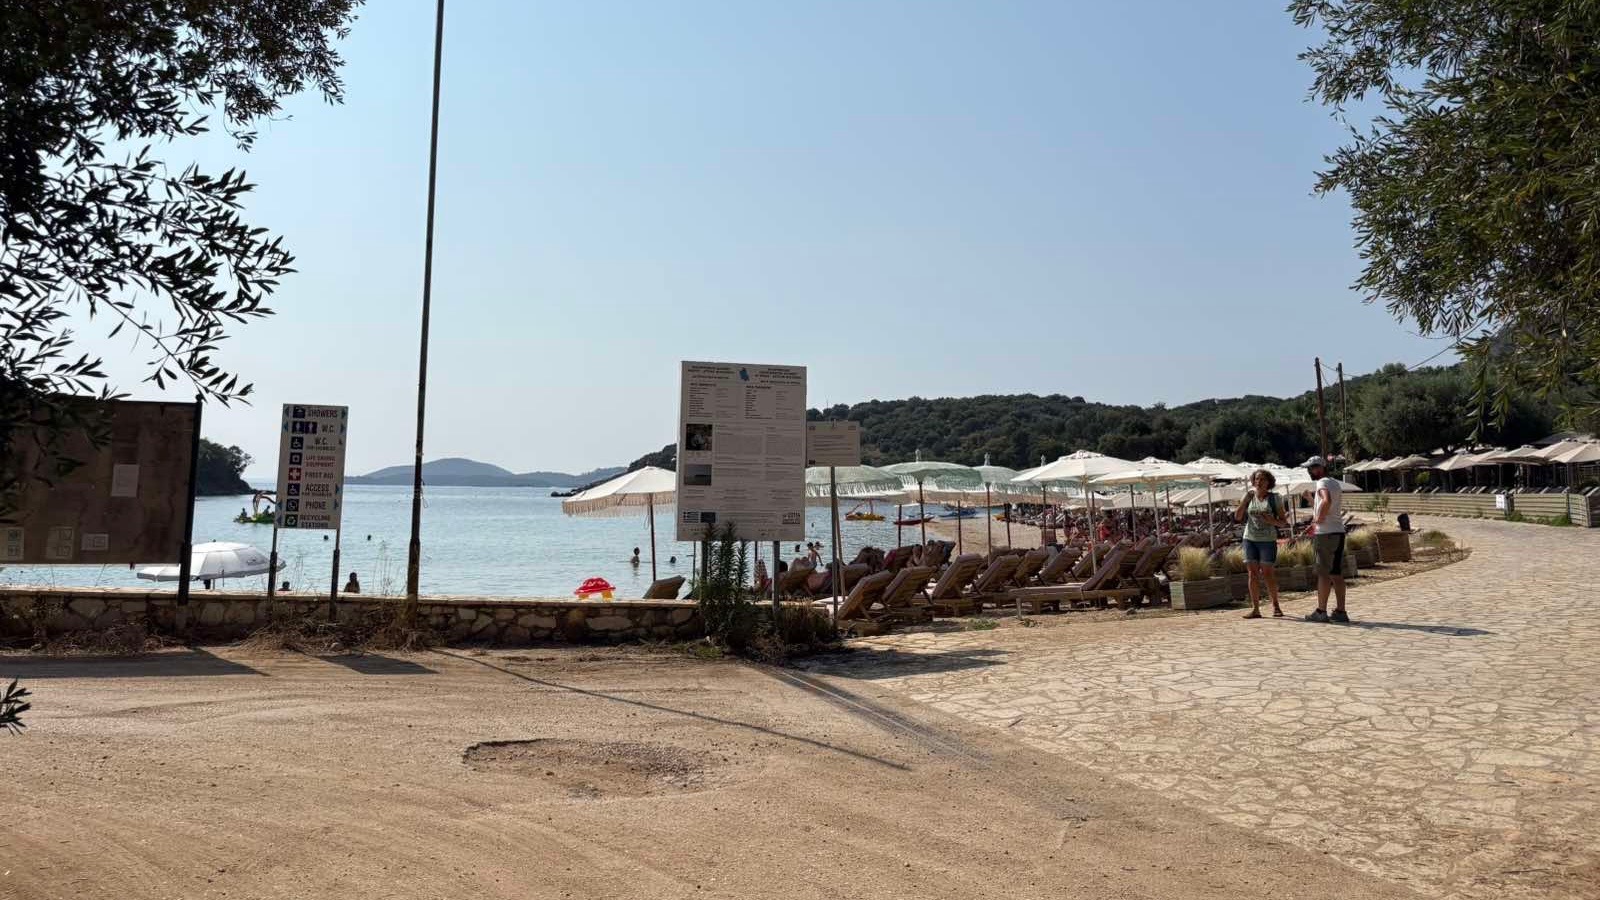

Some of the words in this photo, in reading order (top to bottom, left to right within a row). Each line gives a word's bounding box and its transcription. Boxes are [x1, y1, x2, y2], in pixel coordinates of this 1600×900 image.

[307, 408, 338, 418] SHOWERS
[305, 483, 330, 492] ACCESS
[305, 501, 326, 510] PHONE
